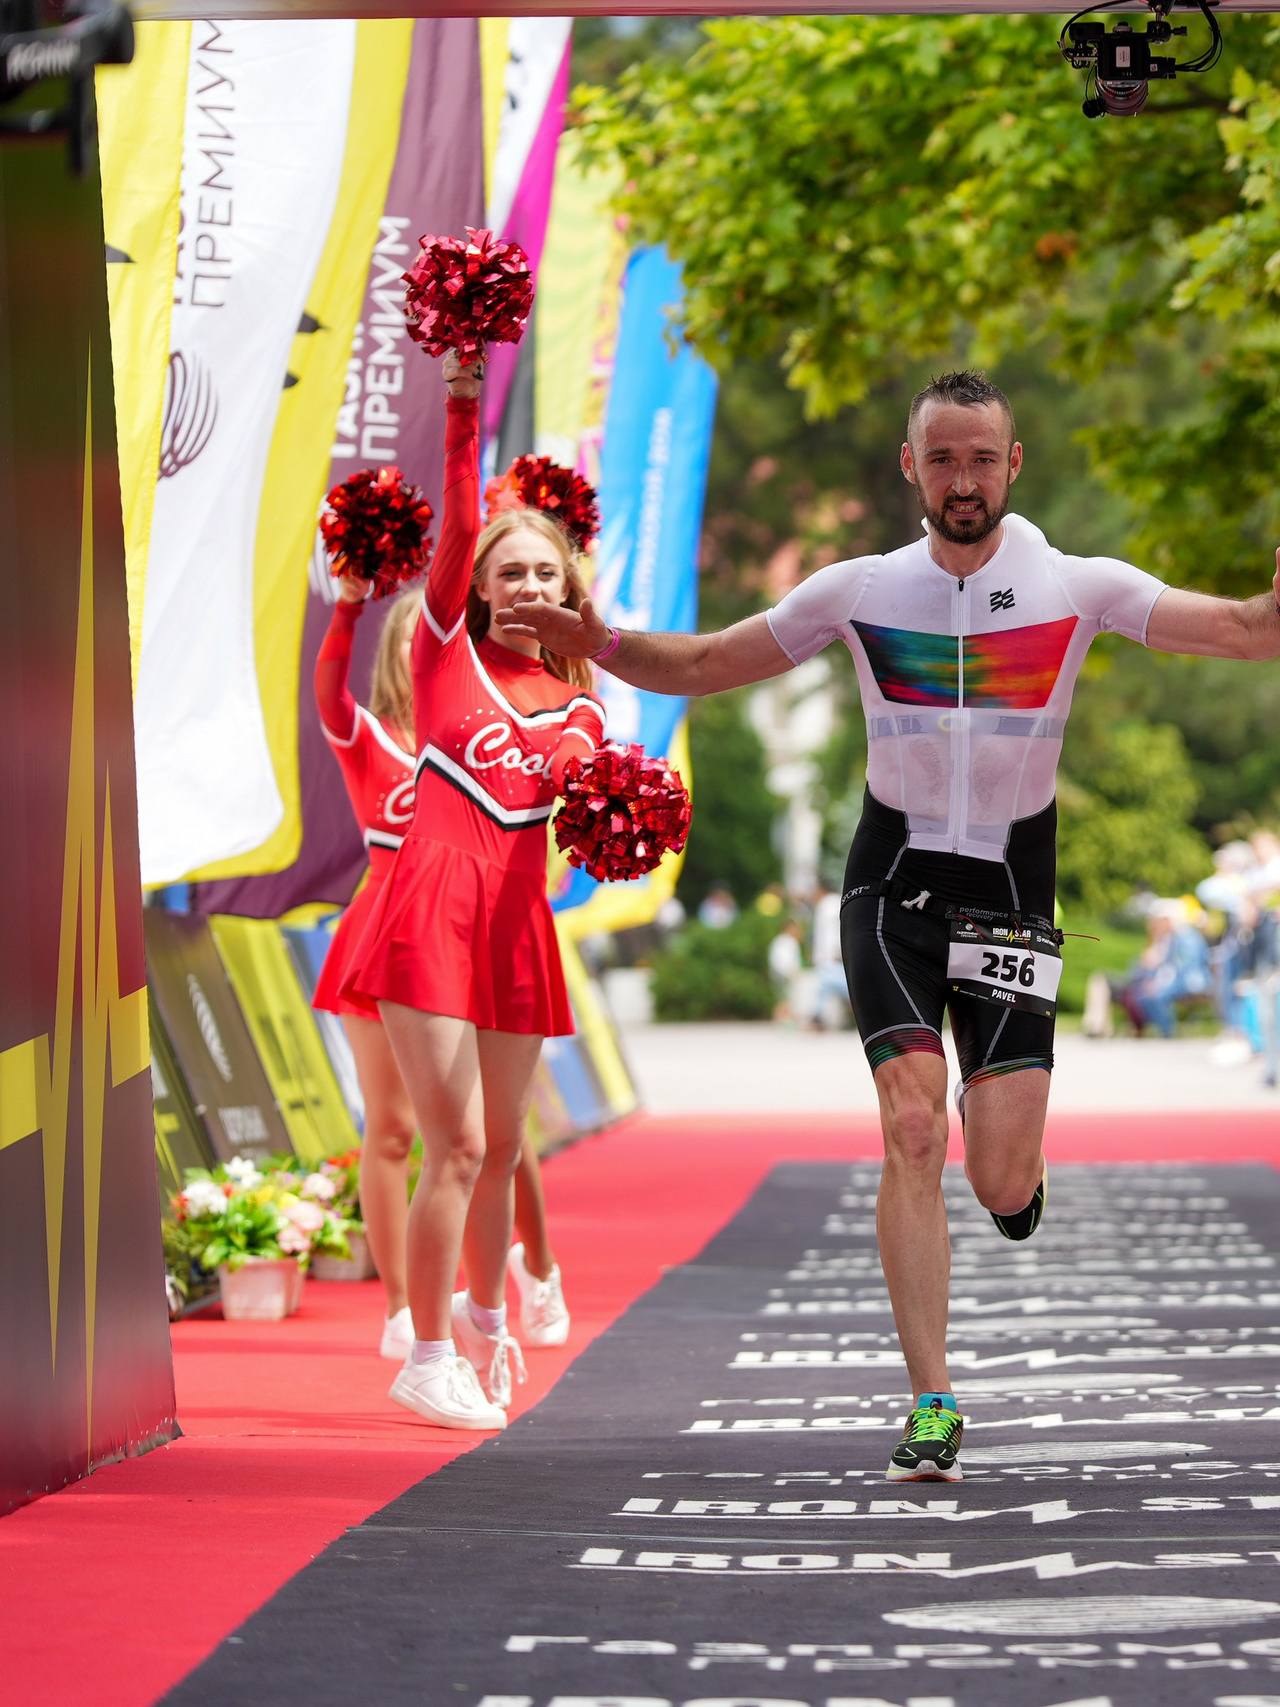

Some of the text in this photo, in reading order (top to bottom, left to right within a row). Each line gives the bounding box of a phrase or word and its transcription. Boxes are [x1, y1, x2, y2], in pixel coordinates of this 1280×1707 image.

[360, 216, 411, 460] ПРЕМИУМ
[980, 951, 1035, 987] 256
[991, 988, 1017, 1003] PAVEL
[621, 1497, 959, 1514] IRON
[580, 1547, 951, 1570] IRON
